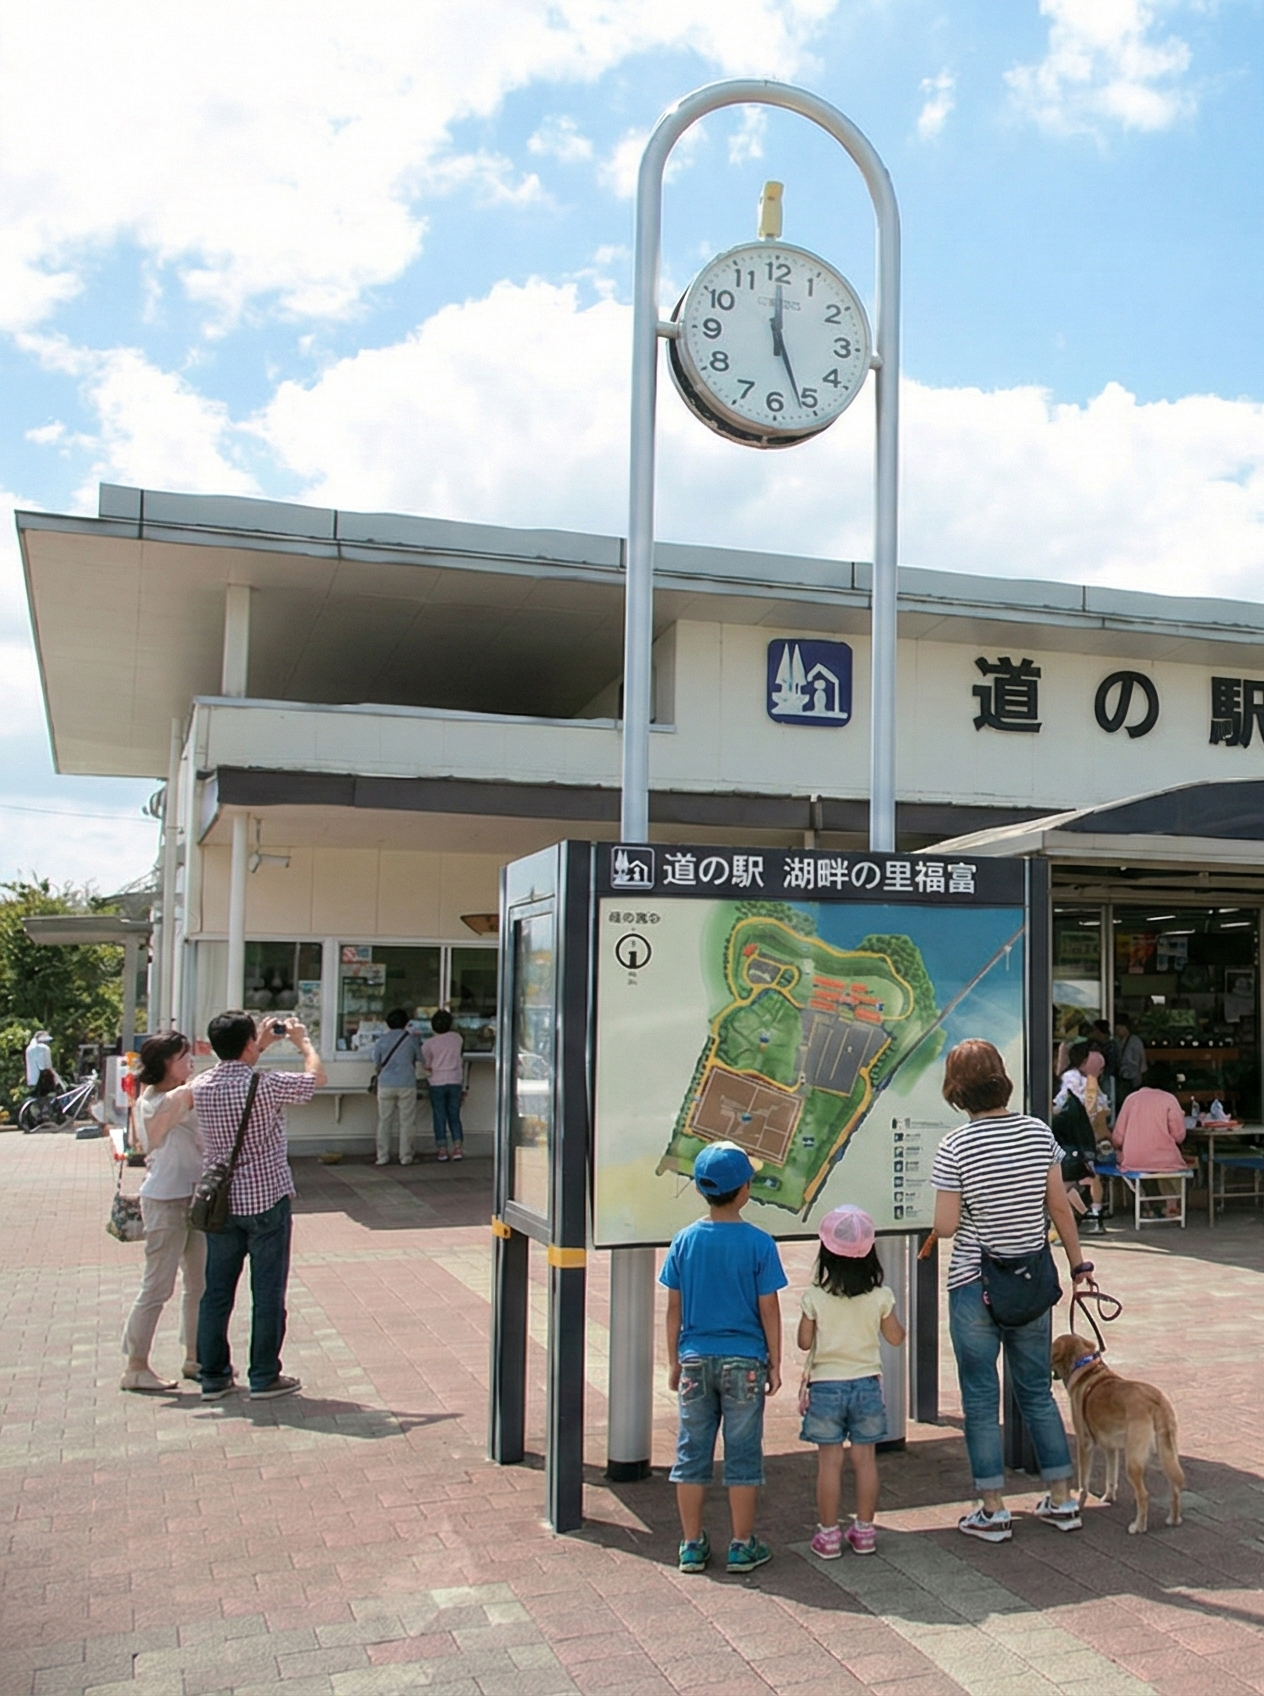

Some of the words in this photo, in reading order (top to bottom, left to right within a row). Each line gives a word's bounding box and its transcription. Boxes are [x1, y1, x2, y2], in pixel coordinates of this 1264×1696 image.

[734, 268, 755, 290] 11
[765, 261, 792, 285] 12
[807, 277, 814, 297] 1
[709, 288, 735, 311] 10
[824, 304, 842, 324] 2
[702, 317, 722, 340] 9
[833, 337, 851, 359] 3
[709, 350, 730, 372] 8
[736, 378, 756, 400] 7
[822, 368, 842, 388] 4
[766, 391, 784, 412] 6
[800, 387, 818, 408] 5
[663, 852, 765, 888] 道の駅
[783, 857, 977, 894] 湖畔の里福富
